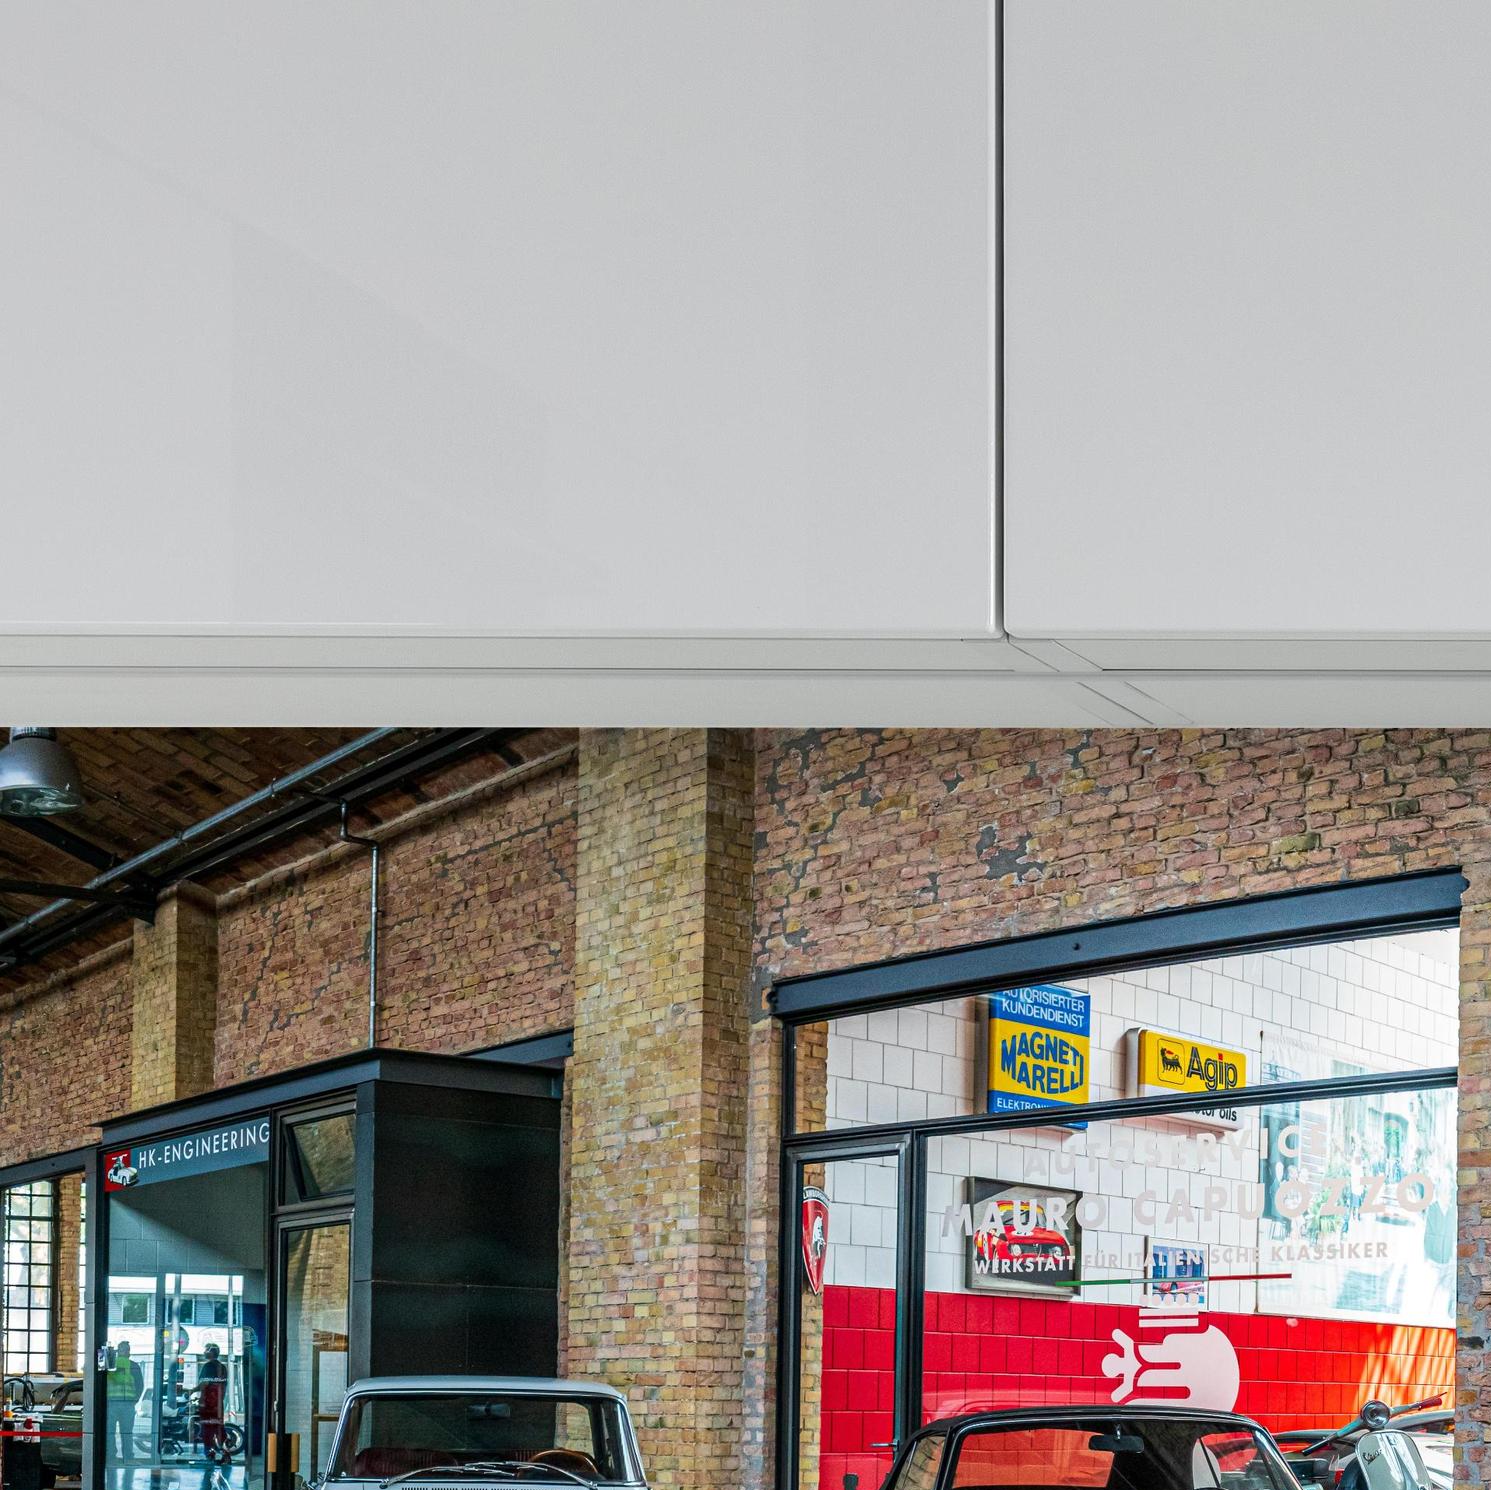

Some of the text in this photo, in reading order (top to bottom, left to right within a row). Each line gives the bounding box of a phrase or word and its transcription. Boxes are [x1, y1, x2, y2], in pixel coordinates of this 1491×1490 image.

[1002, 999, 1085, 1028] KUNDENDIENST
[1187, 1046, 1238, 1091] Agip
[1219, 1106, 1238, 1122] oils
[138, 1122, 270, 1170] HK-ENGINEERING
[1024, 1123, 1328, 1178] AUTOSERVICE
[941, 1172, 1434, 1238] MAURO CAPUOZZO
[974, 1241, 1389, 1275] WERKSTATT FÜR ITALIENISCHE KLASSIKER
